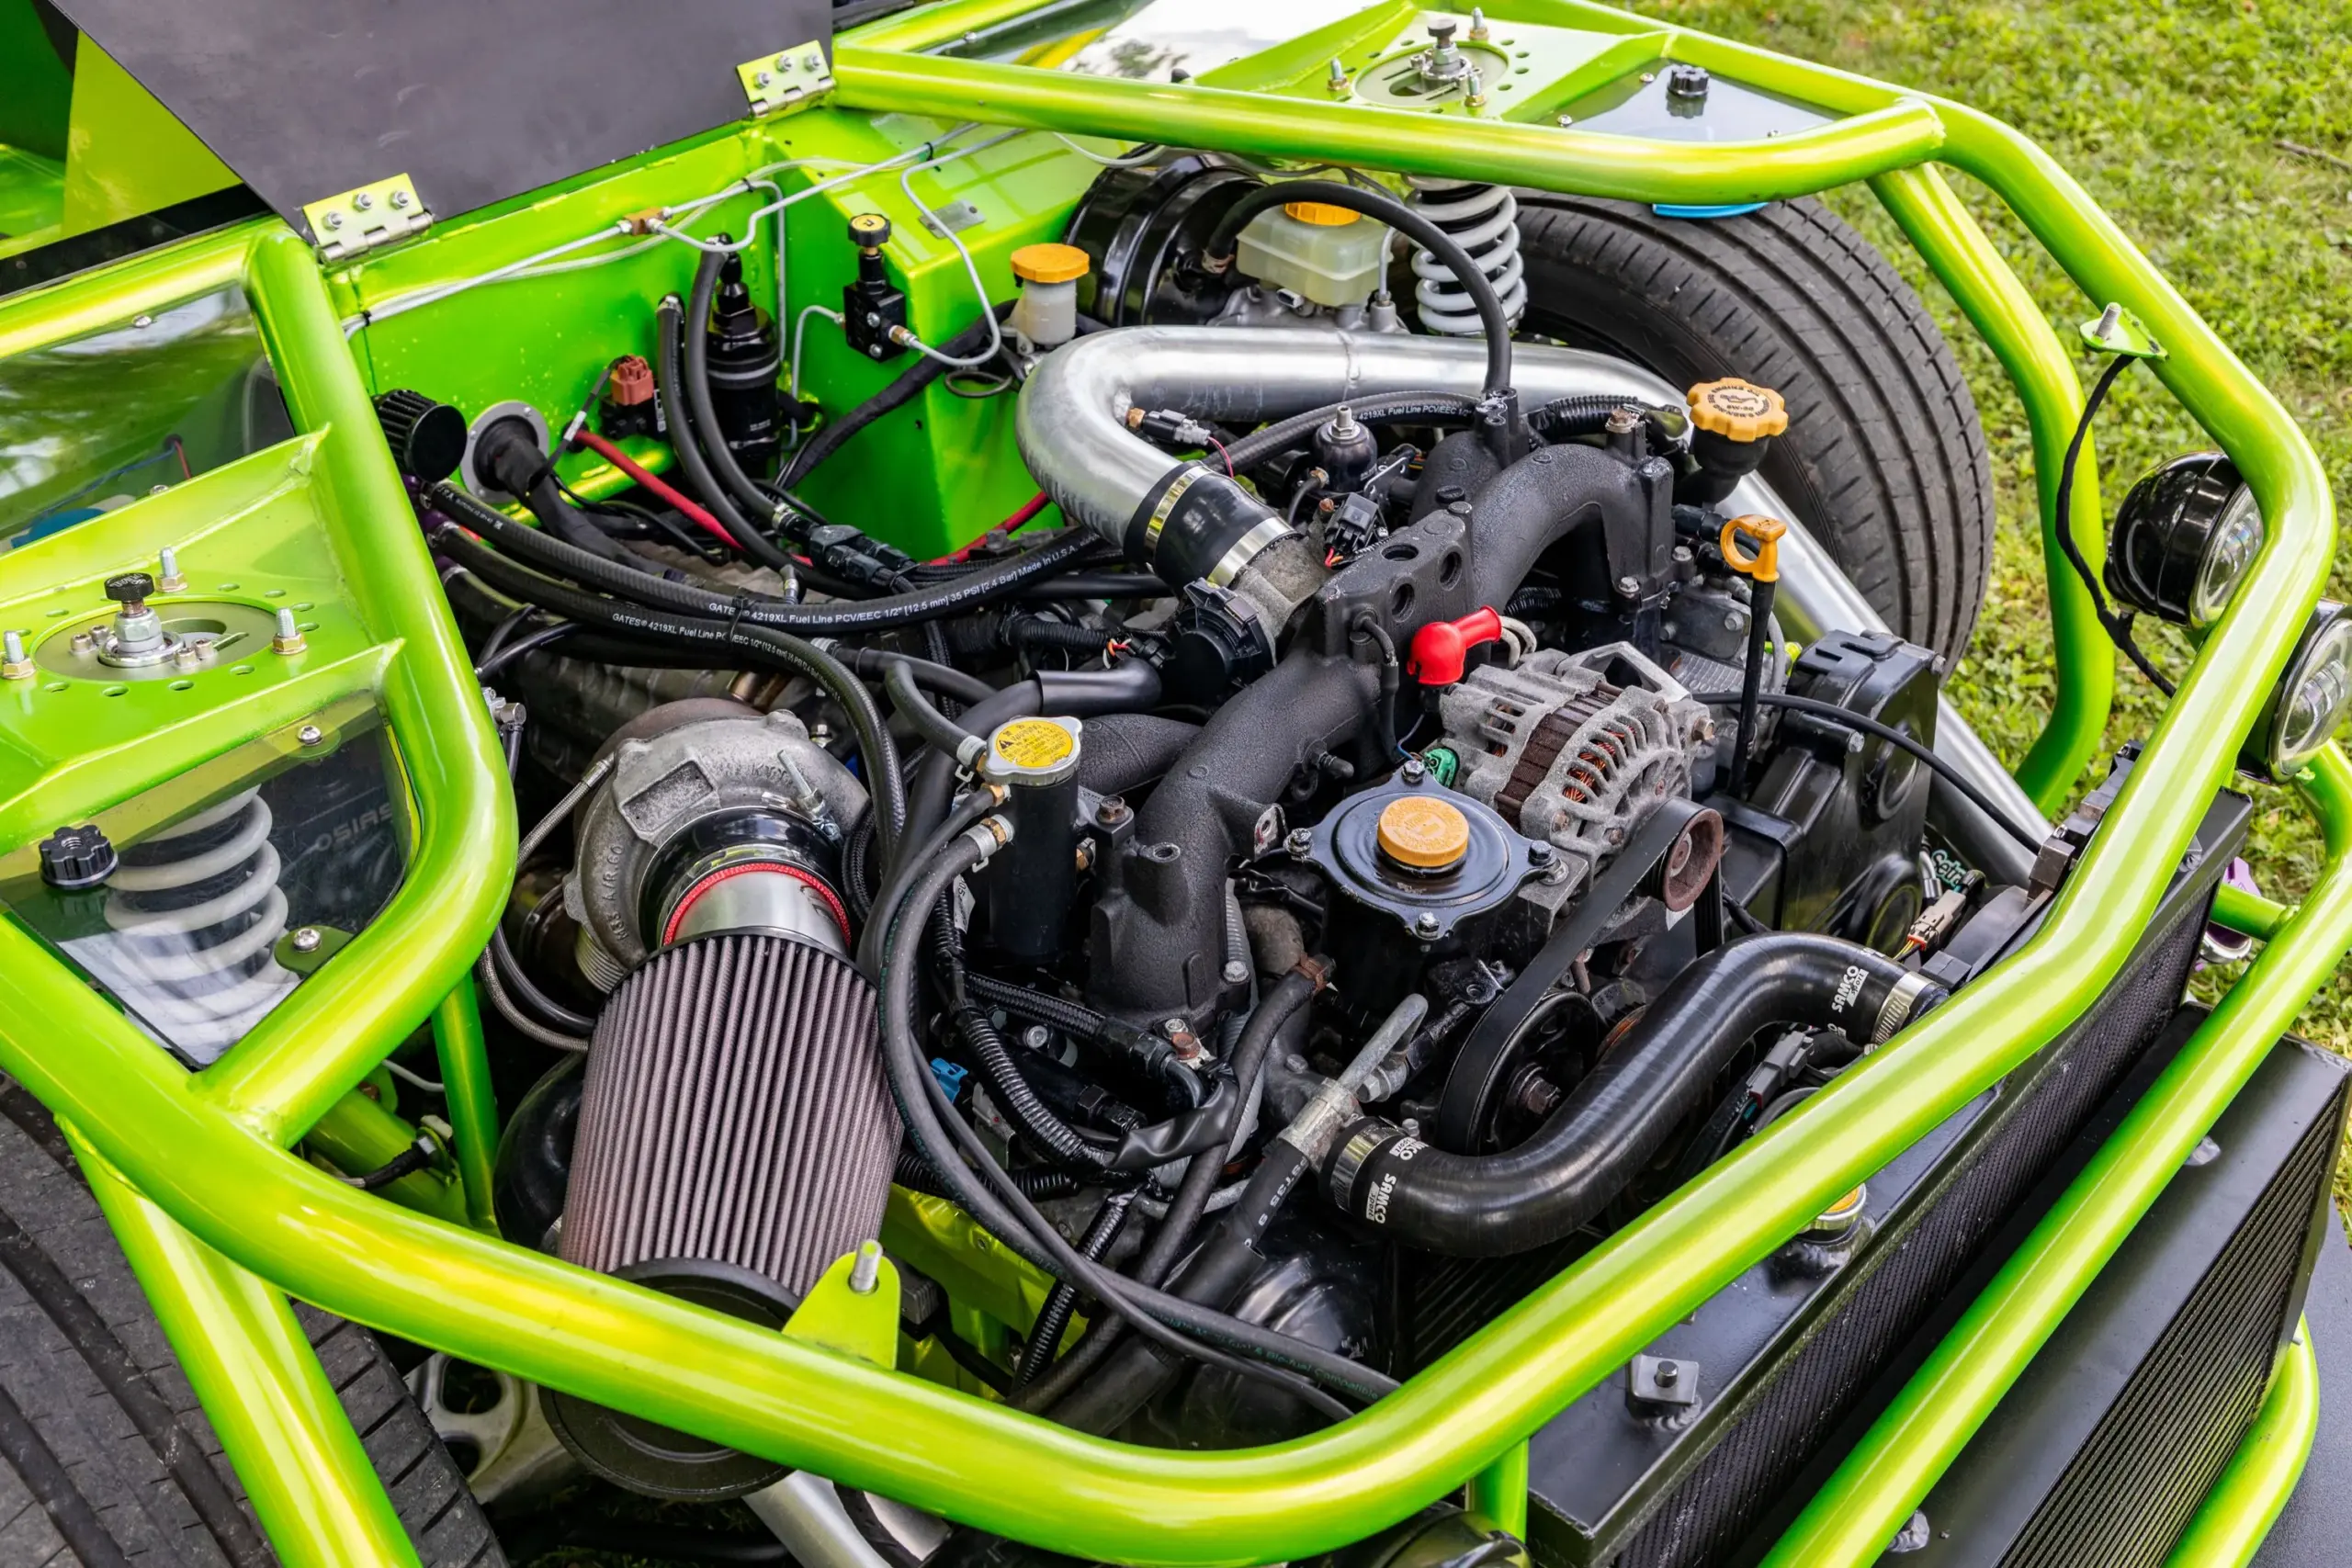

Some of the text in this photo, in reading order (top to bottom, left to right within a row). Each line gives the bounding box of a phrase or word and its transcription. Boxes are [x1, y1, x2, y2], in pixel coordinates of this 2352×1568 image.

[1359, 410, 1386, 421] 4219XL
[1388, 407, 1404, 416] Fuel
[1406, 405, 1421, 413] Line
[1422, 404, 1457, 414] PCV/EEC
[751, 612, 787, 623] 4219XL
[789, 615, 810, 624] Fuel
[812, 615, 833, 624] Line
[835, 611, 881, 623] PCV/EEC
[930, 596, 949, 610] mm]
[951, 592, 963, 603] 35
[964, 586, 981, 599] PSI
[999, 571, 1018, 586] Bar]
[1019, 561, 1042, 577] Made
[649, 620, 677, 634] 4219XL
[679, 626, 696, 637] Fuel
[698, 628, 714, 639] Line
[1831, 965, 1859, 1013] SAMCO
[1374, 1173, 1396, 1224] SAMCO
[1315, 1364, 1379, 1400] Compatible
